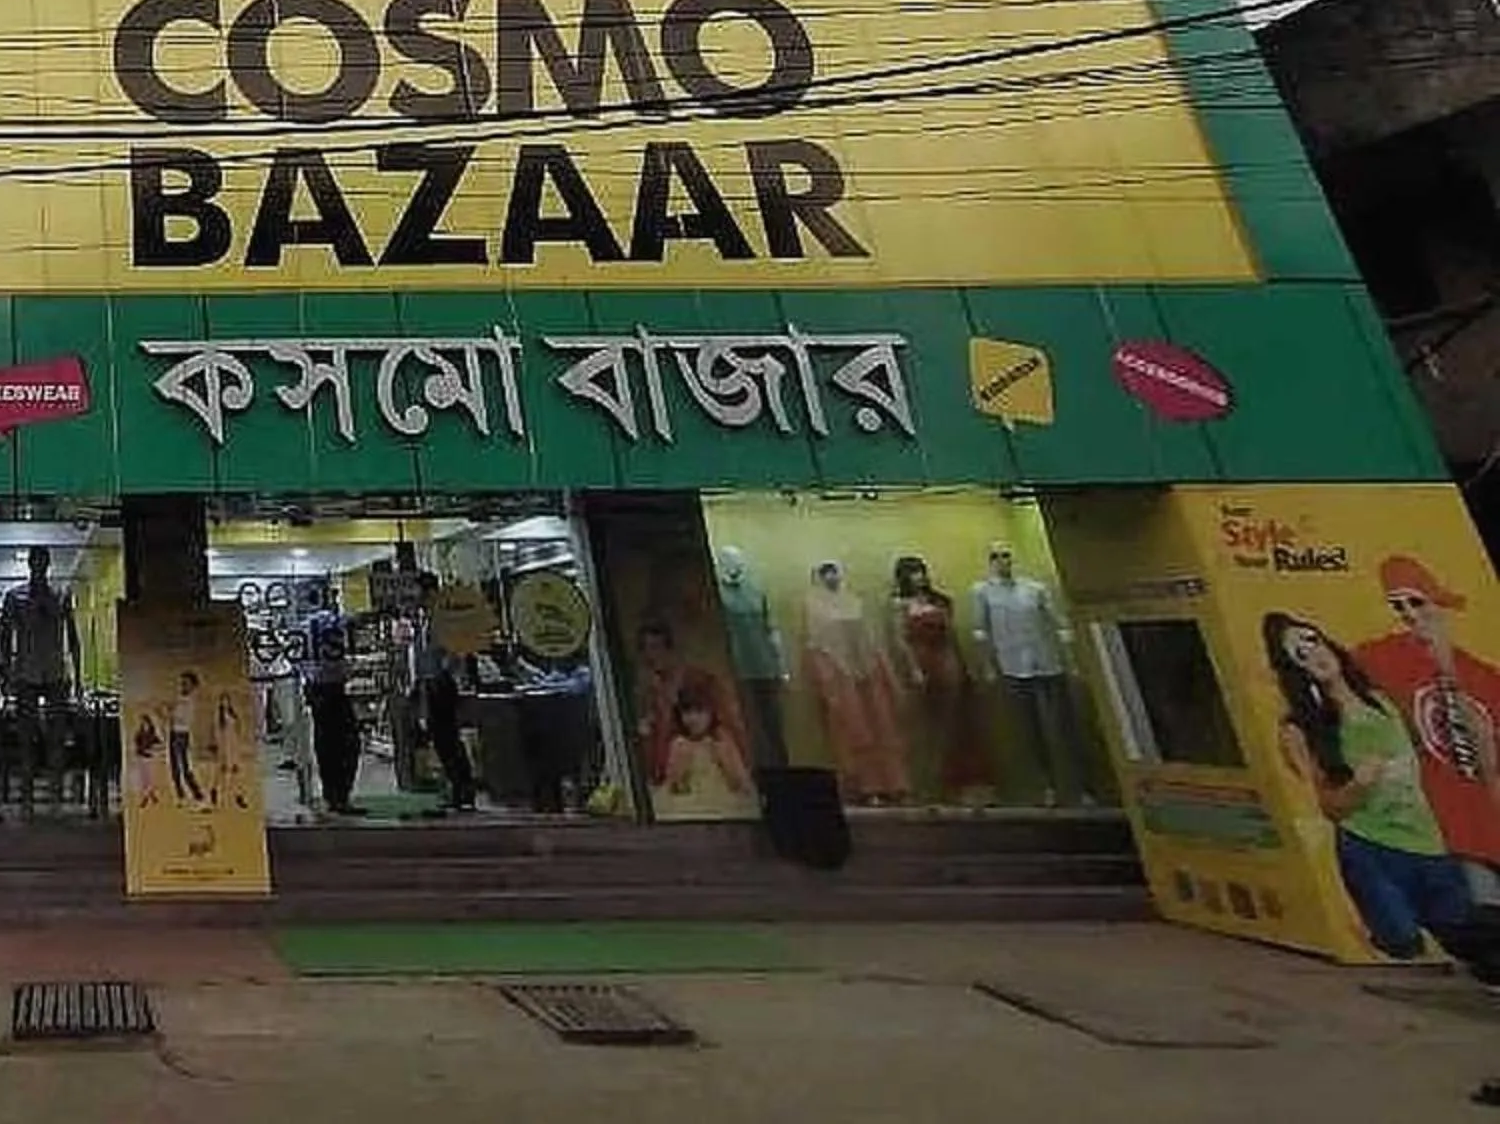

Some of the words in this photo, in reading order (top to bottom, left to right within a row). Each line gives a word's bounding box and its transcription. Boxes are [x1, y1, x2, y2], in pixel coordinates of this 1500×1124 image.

[130, 140, 870, 267] BAZAAR
[139, 325, 527, 443] কসমো
[543, 325, 915, 443] বাজার
